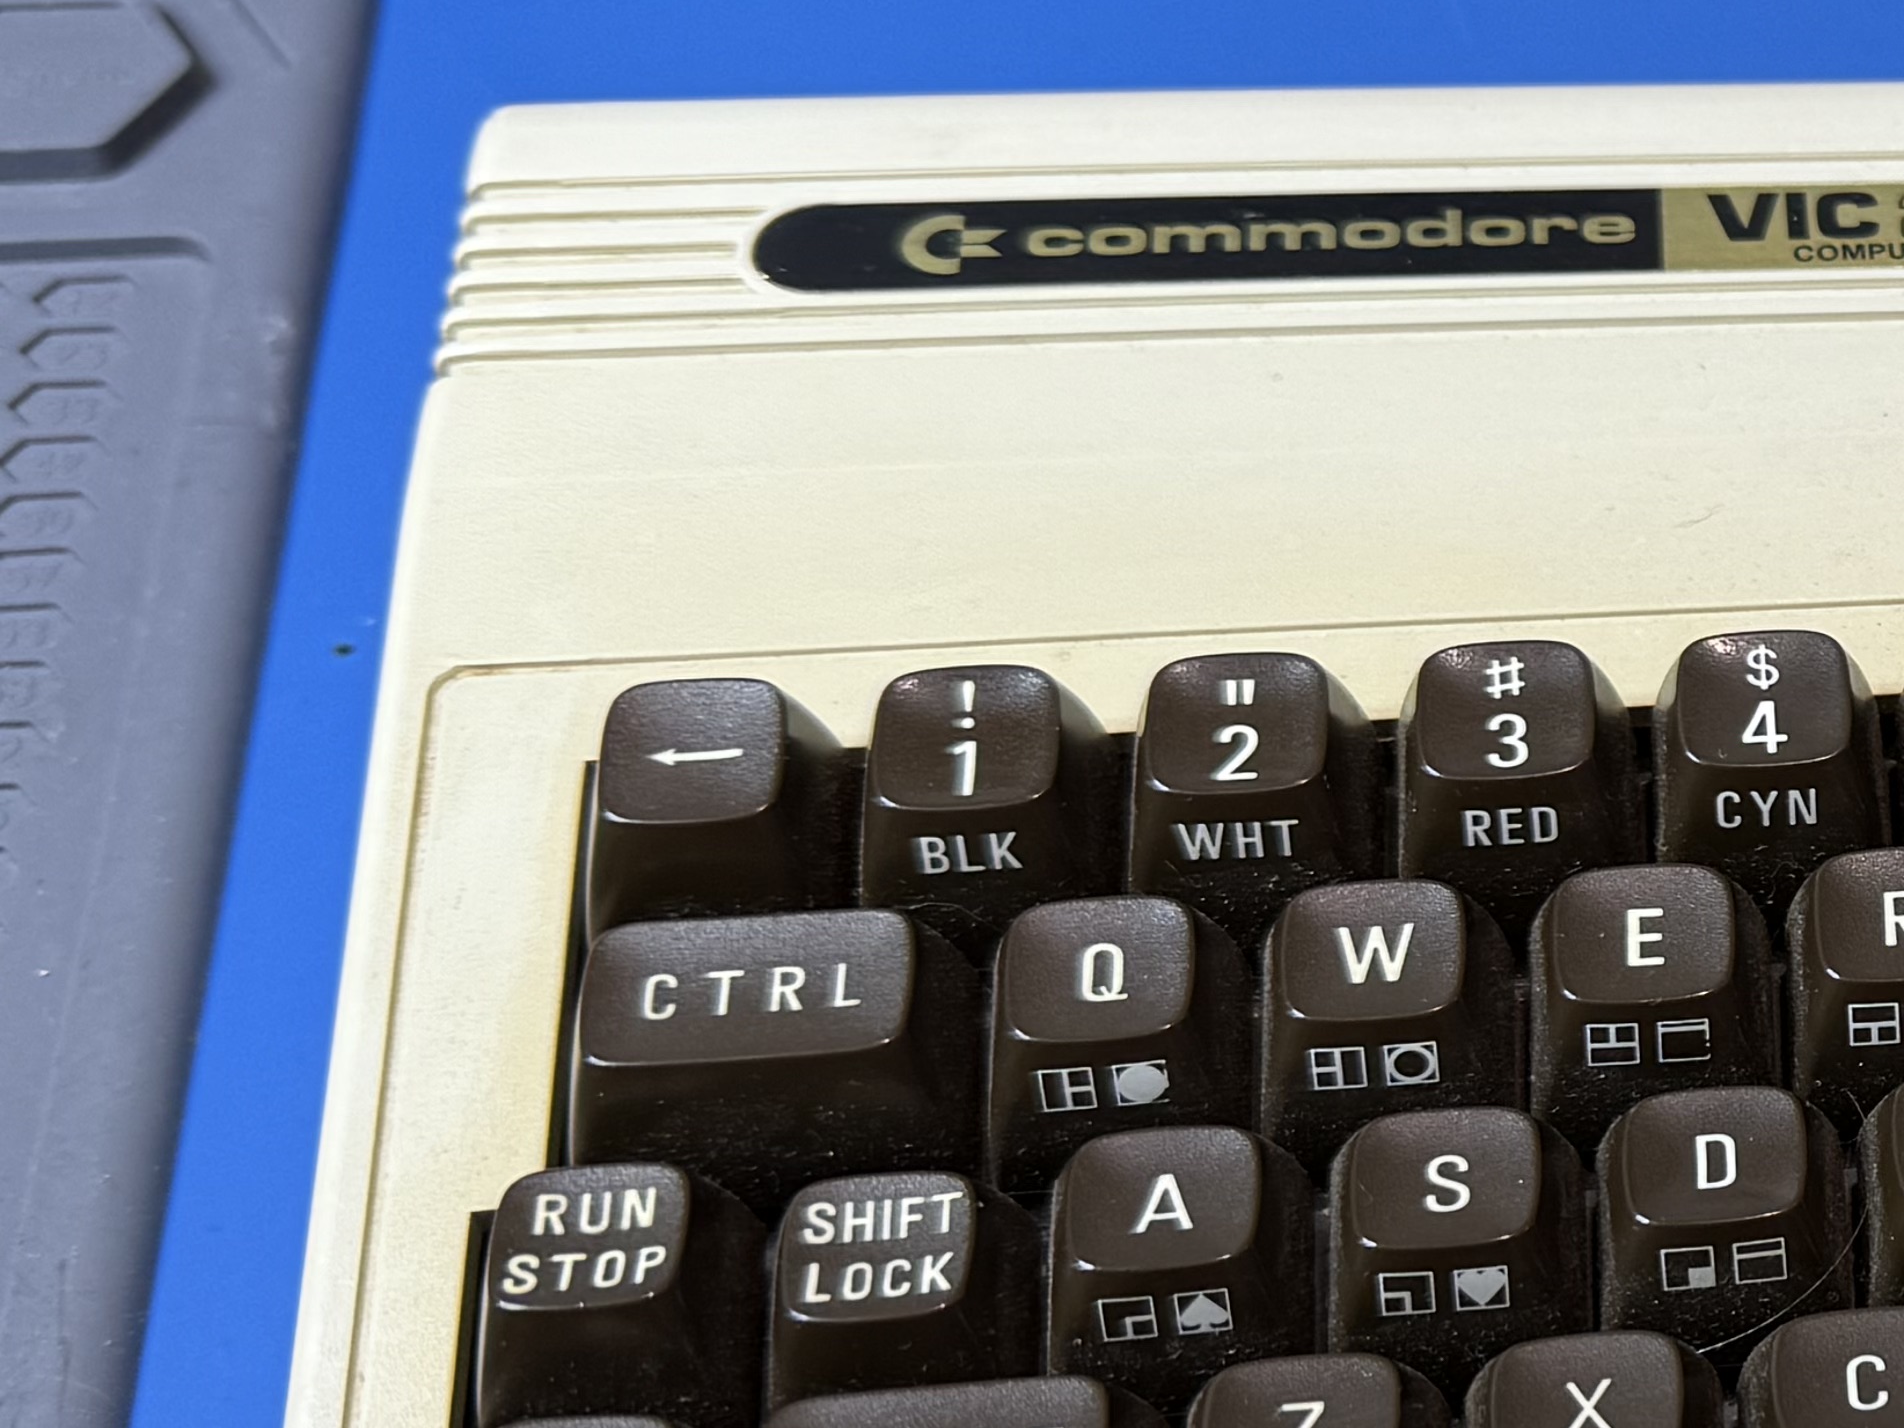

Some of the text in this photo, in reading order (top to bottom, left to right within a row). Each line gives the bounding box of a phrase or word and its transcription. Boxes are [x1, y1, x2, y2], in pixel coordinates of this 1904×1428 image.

[1024, 208, 1636, 257] commodore
[1706, 189, 1883, 243] VIC
[1223, 678, 1255, 706] "
[1483, 656, 1526, 699] #
[1745, 643, 1780, 691] $
[958, 680, 976, 729] !
[1741, 700, 1788, 754] 4
[1213, 724, 1259, 781] 2
[1487, 713, 1529, 768] 3
[950, 740, 977, 797] 1
[1463, 806, 1559, 847] RED
[1715, 787, 1817, 829] CYN
[915, 831, 1023, 875] BLK
[1176, 819, 1299, 861] WHT
[1337, 922, 1415, 984] W
[1626, 907, 1665, 967] E
[642, 962, 861, 1020] CTRL
[1081, 942, 1129, 1002] Q
[1425, 1154, 1471, 1213] S
[1695, 1133, 1737, 1190] D
[533, 1186, 657, 1236] RUN
[802, 1191, 964, 1244] SHIFT
[1134, 1173, 1194, 1234] A
[502, 1245, 667, 1295] STOP
[804, 1251, 954, 1303] LOCK
[1846, 1354, 1889, 1411] C
